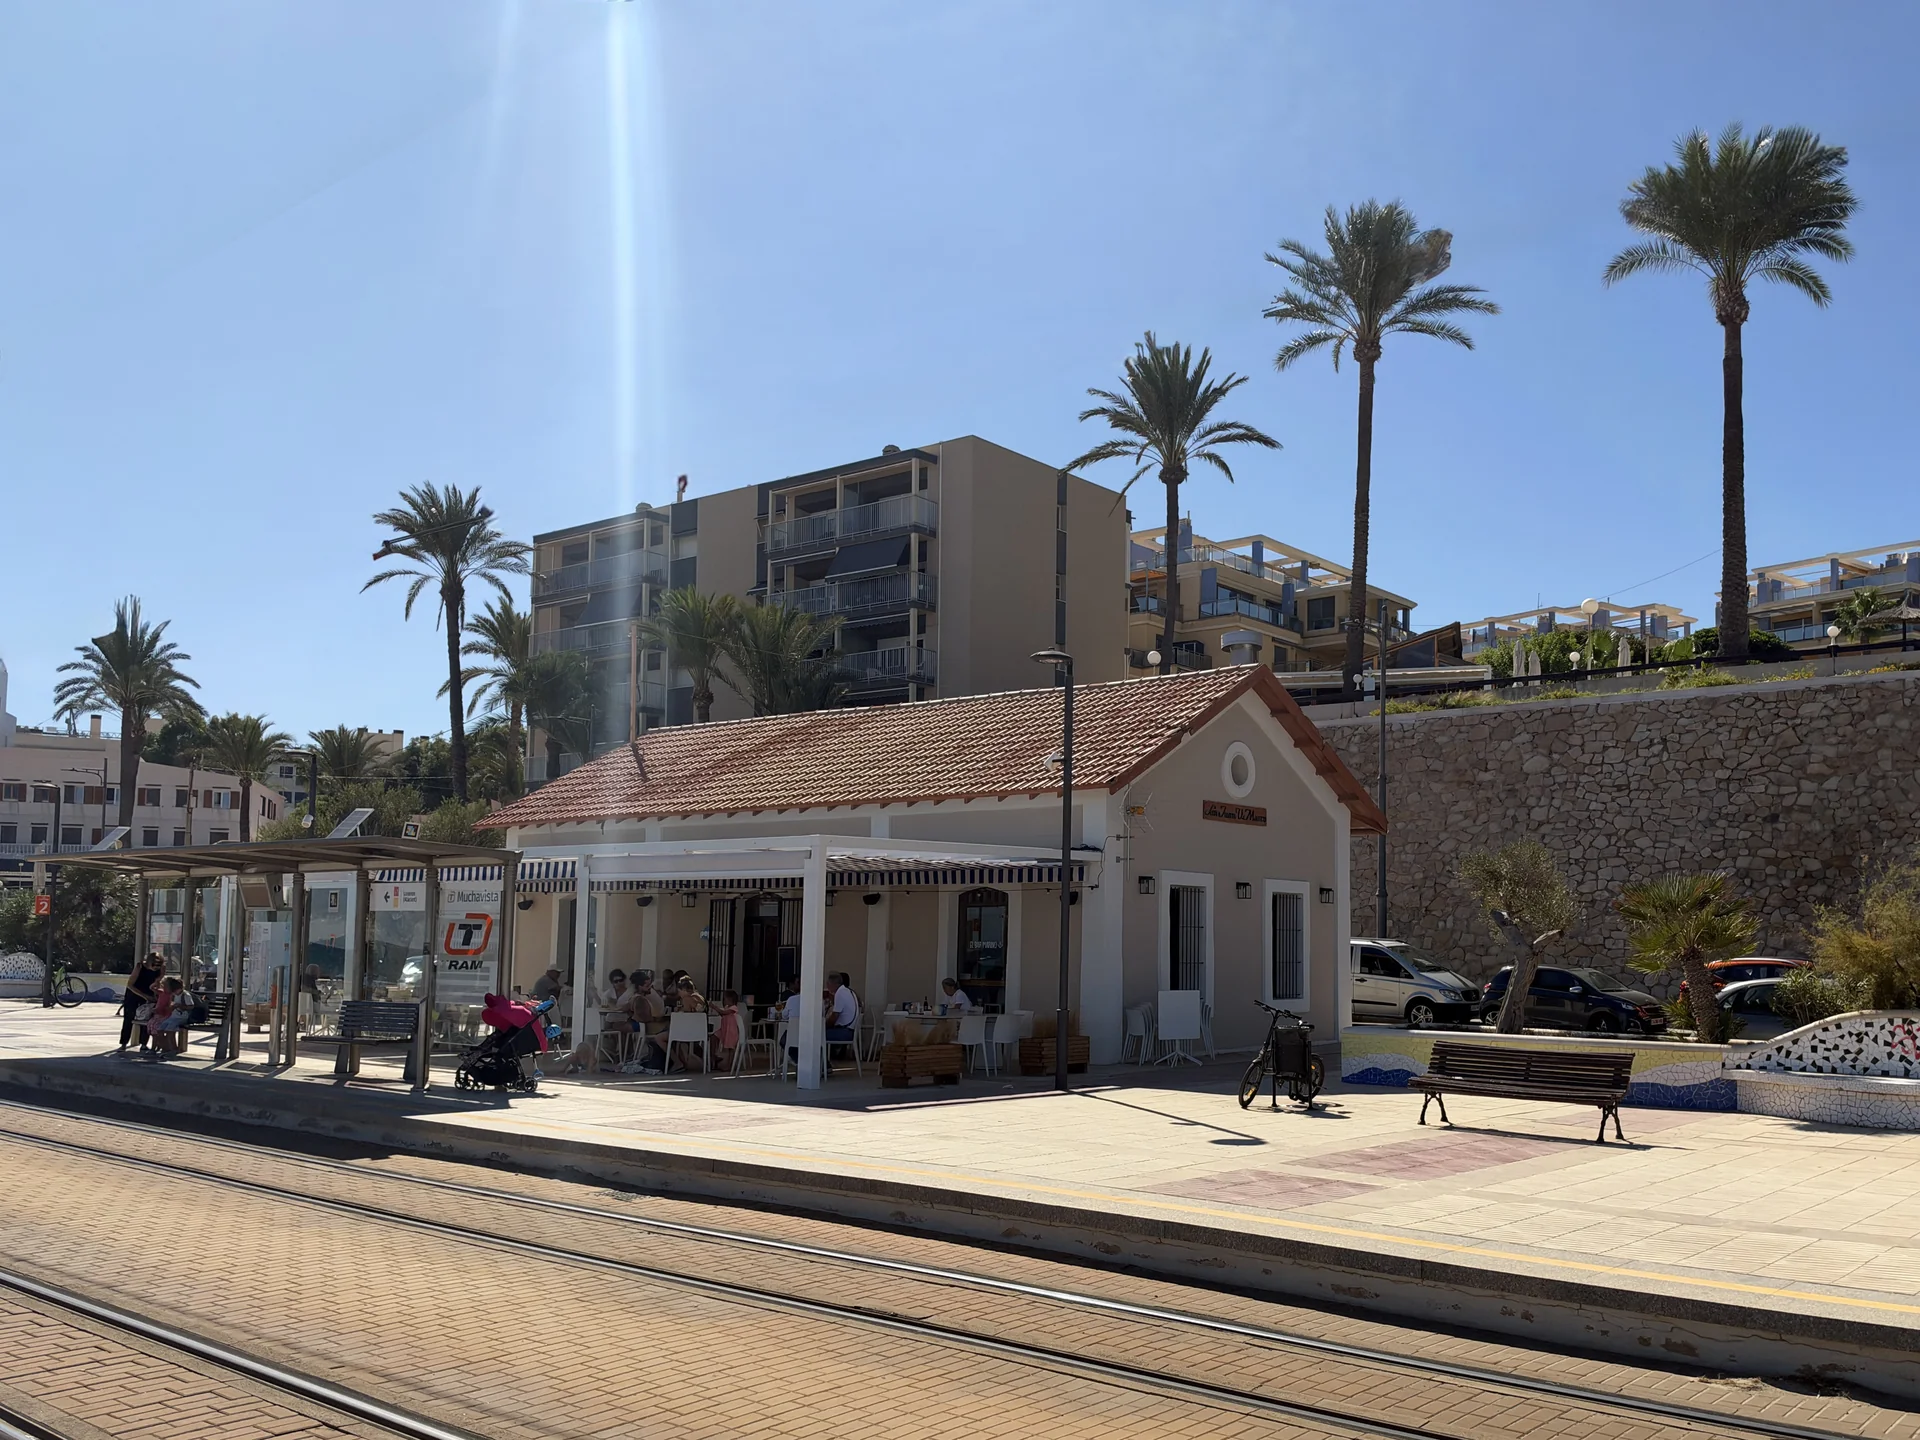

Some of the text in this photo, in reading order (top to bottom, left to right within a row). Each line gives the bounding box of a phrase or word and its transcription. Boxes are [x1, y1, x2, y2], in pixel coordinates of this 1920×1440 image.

[457, 889, 499, 903] Muchavista
[39, 901, 48, 914] 2
[441, 960, 483, 970] RAM
